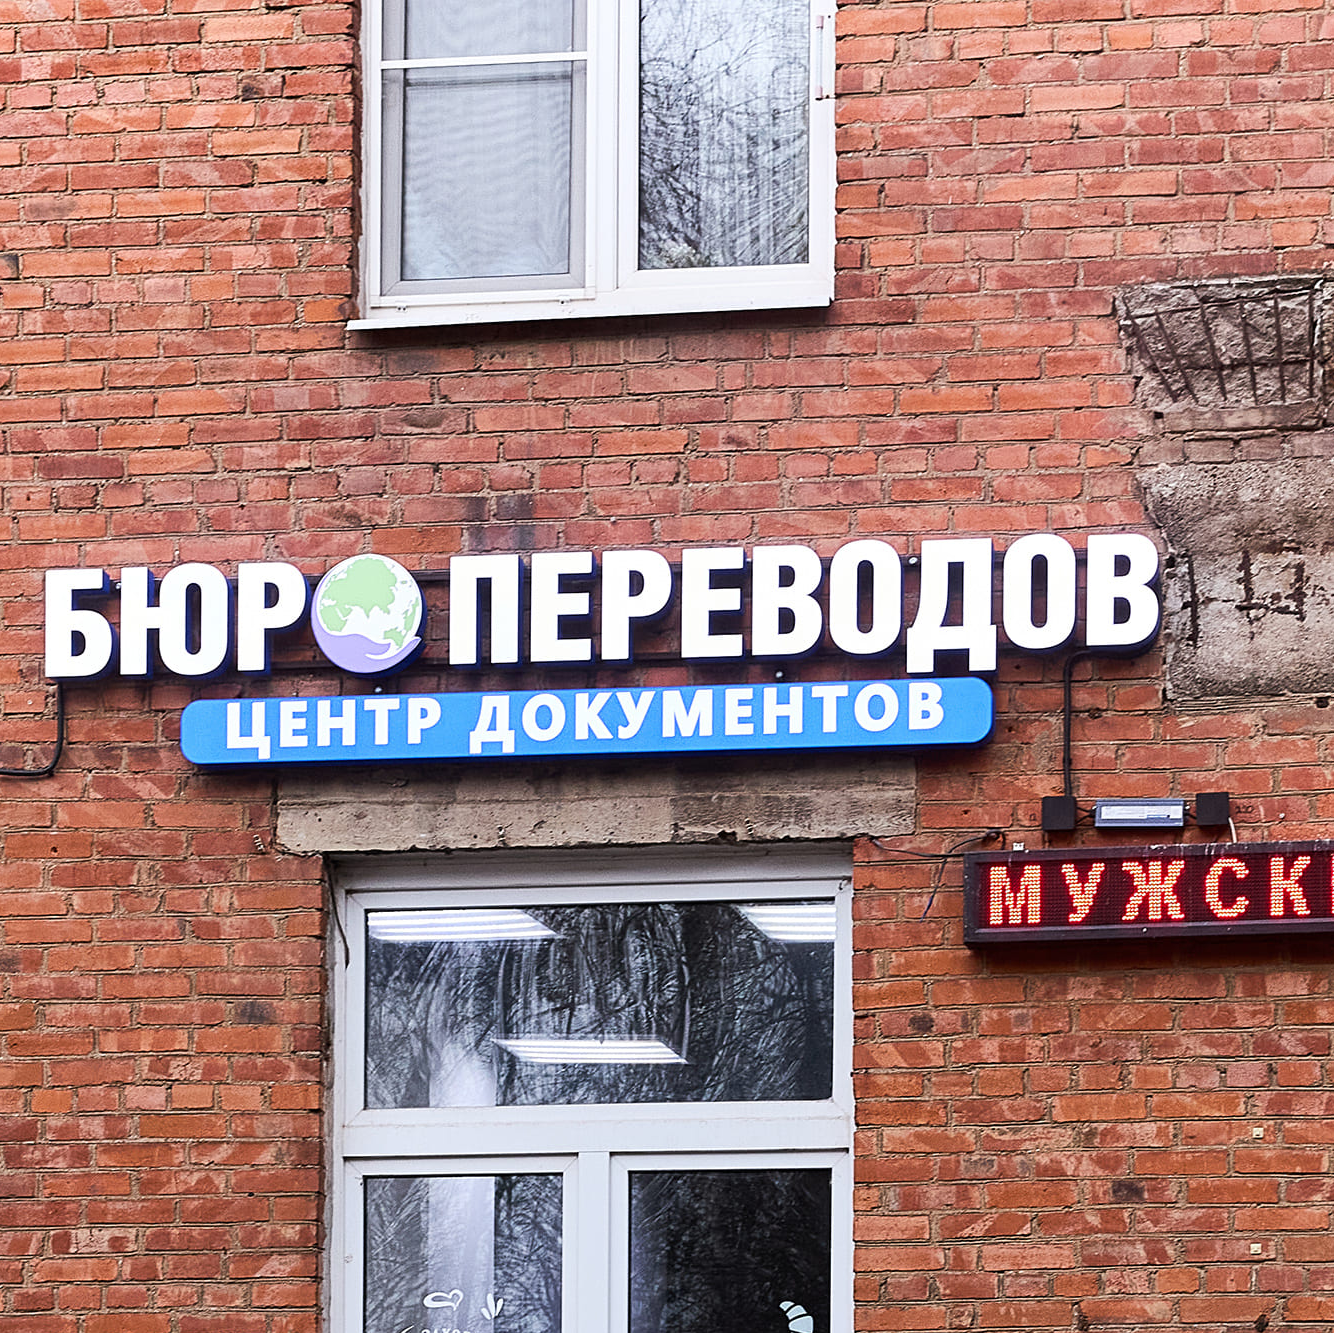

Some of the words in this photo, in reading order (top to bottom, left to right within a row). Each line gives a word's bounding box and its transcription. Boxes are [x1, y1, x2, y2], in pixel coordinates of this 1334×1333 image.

[449, 534, 1160, 673] ПЕРЕВОДОВ
[224, 695, 443, 759] ЦЕНТР
[468, 682, 945, 756] ДОКУМЕНТОВ
